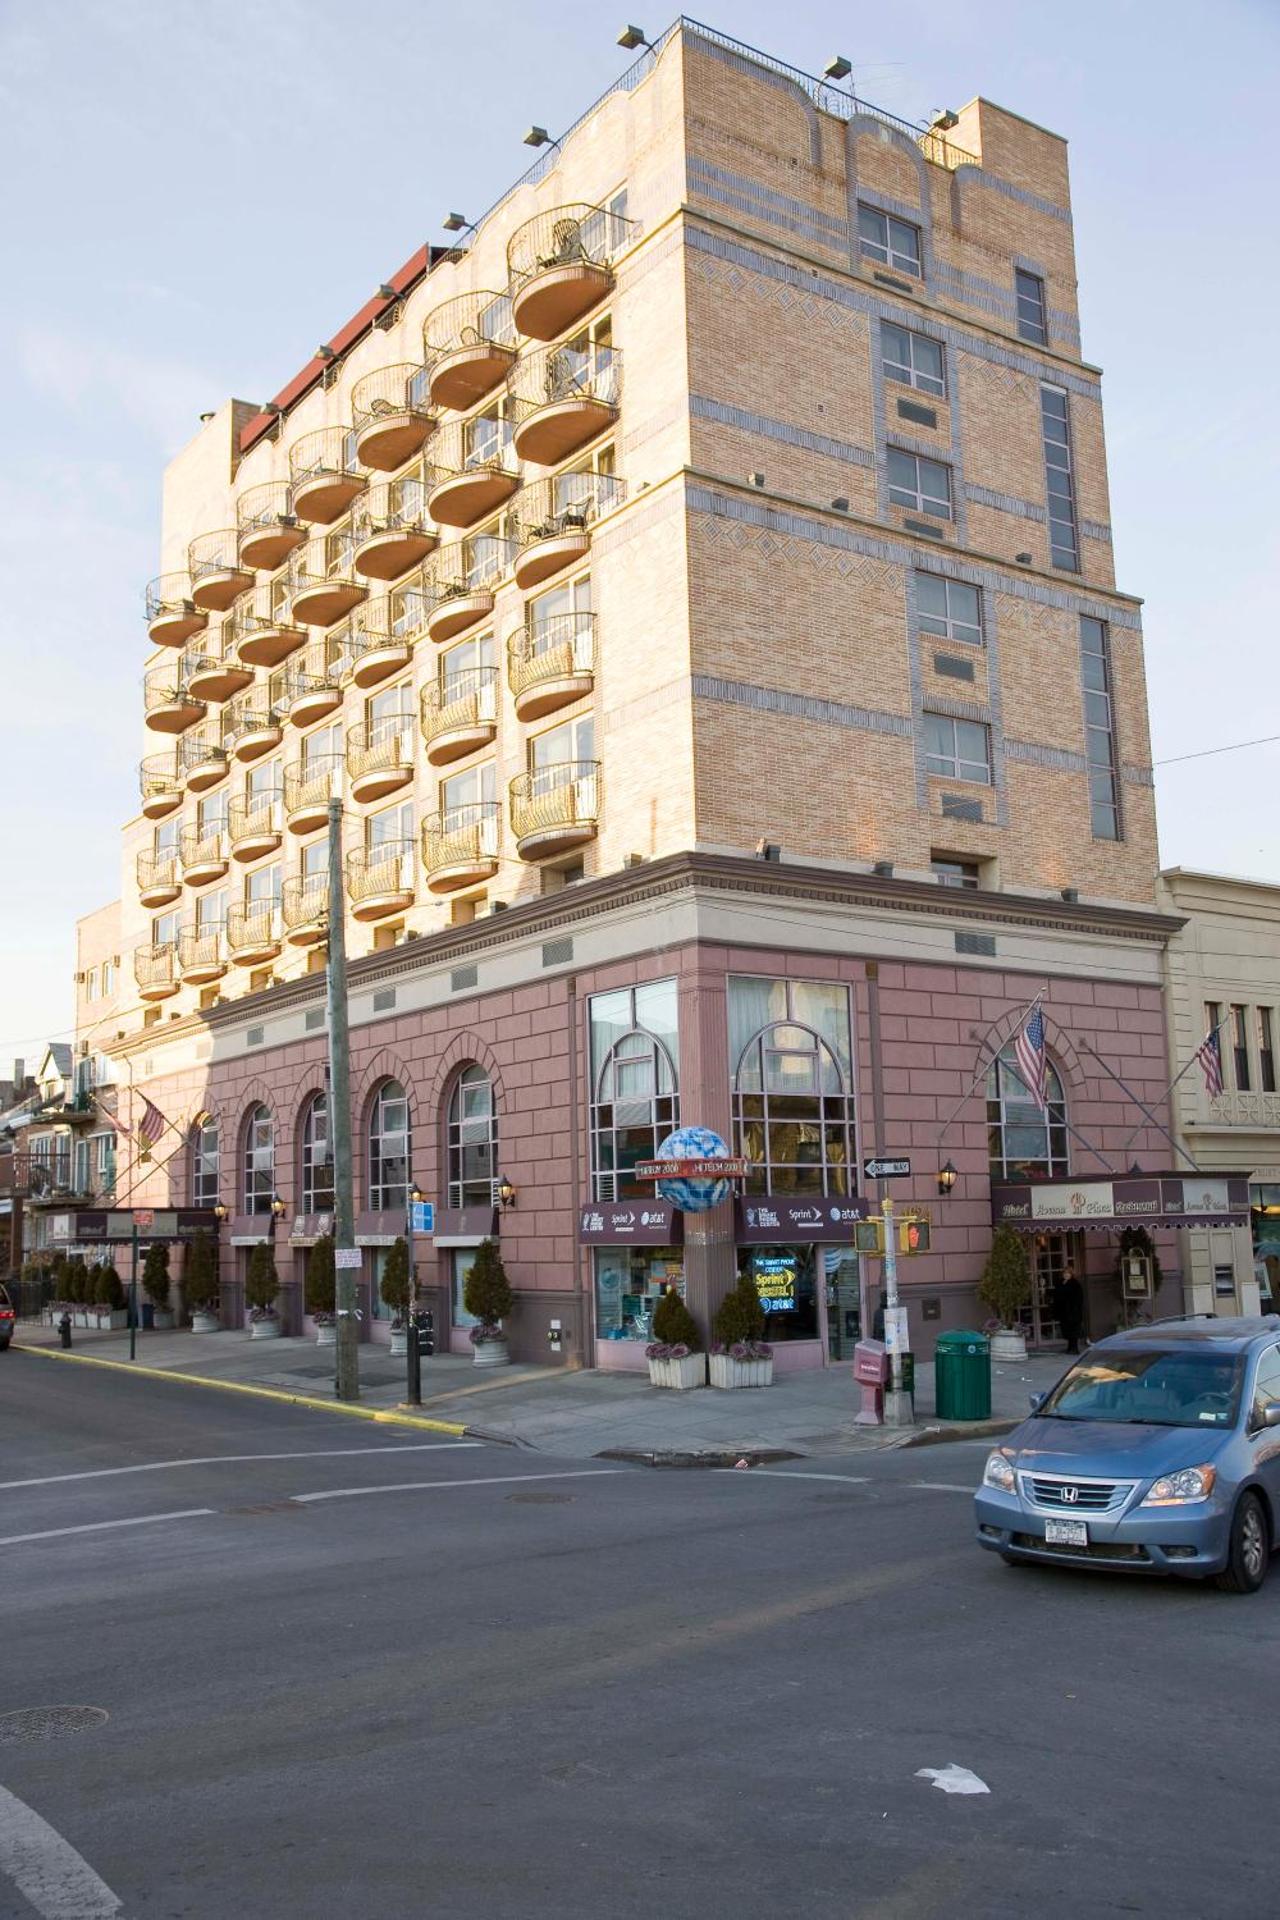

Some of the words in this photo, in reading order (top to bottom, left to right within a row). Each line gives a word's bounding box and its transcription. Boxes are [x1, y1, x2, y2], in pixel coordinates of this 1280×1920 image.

[870, 1164, 887, 1173] ONE
[893, 1162, 908, 1171] WAY
[789, 1209, 811, 1220] Sprint
[756, 1273, 784, 1287] Sprint
